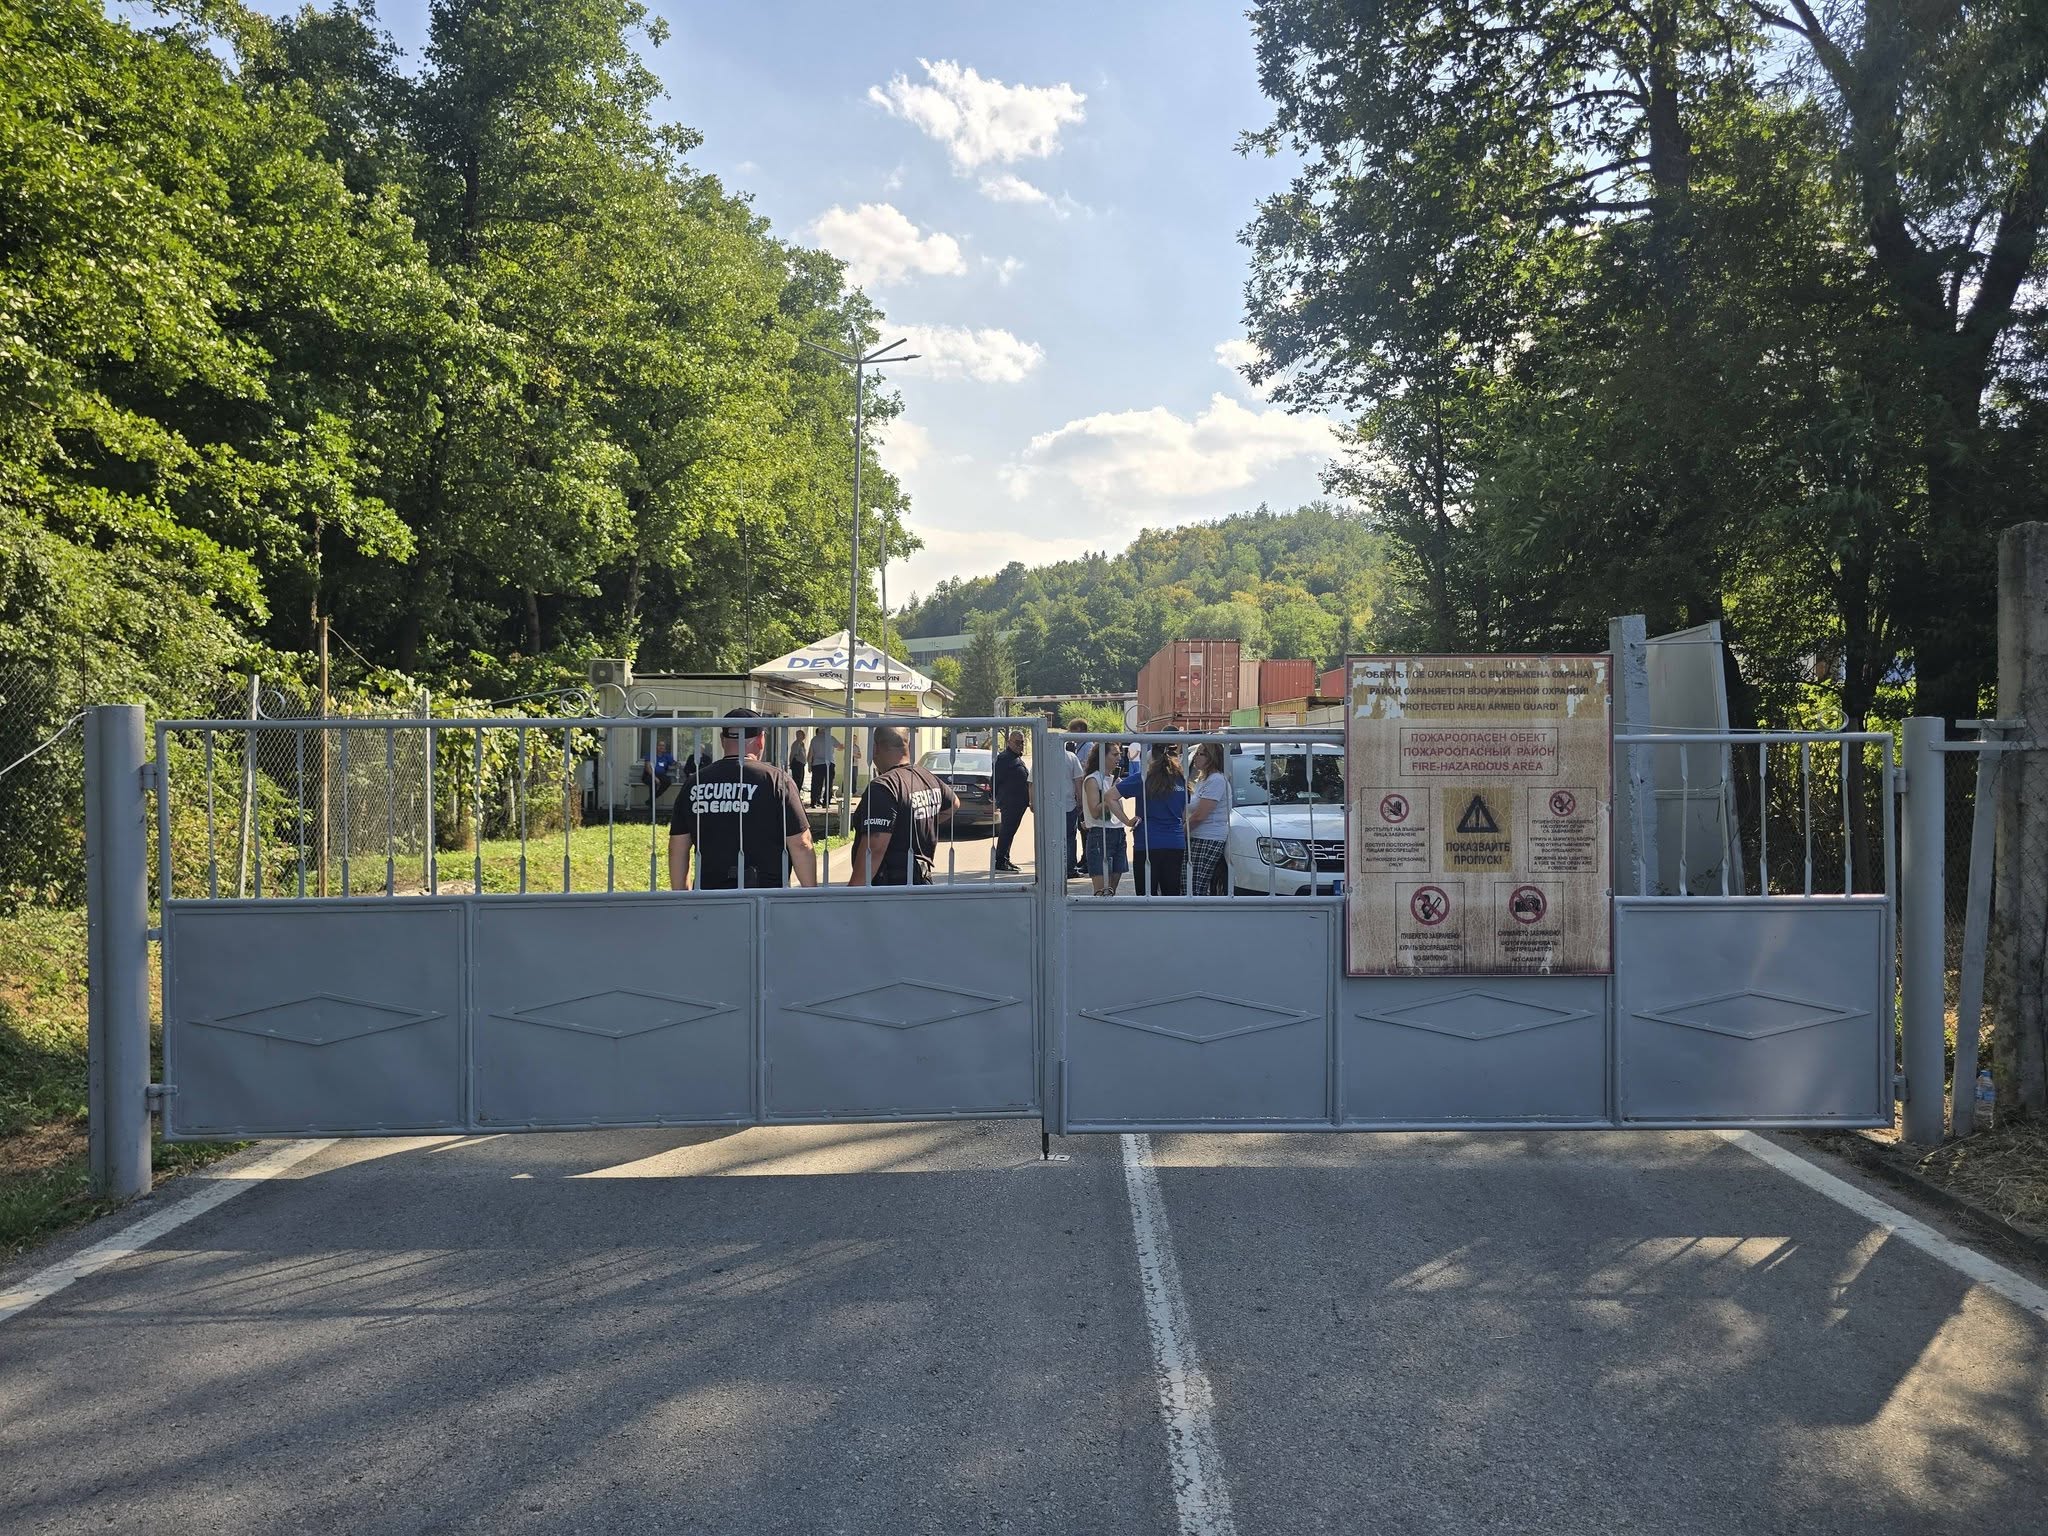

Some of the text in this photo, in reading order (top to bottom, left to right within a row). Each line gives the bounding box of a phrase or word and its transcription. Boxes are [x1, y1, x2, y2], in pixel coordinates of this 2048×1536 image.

[787, 653, 879, 670] DEVN
[1366, 671, 1409, 679] ОБЕКТЪТ
[1412, 671, 1425, 679] СЕ
[1427, 671, 1477, 679] ОХРАНЯВА
[1369, 686, 1589, 695] РАЙОН ОХРАНЯЕТСЯ ВООРУЖЕННОЙ ОХРАНОЙ!
[1400, 703, 1559, 711] PROTECTED AREA! ARMED GUARD!
[1411, 733, 1547, 742] ПОЖАРООПАСЕН ОБЕКТ
[1403, 746, 1555, 756] ПОЖАРООПАСНЫЙ РАЙОН
[1412, 762, 1543, 771] FIRE-HAZARDOUS AREA
[689, 783, 758, 801] SECURITY
[1446, 841, 1511, 852] ПОКАЗВАЙТЕ
[1454, 855, 1502, 865] ПРОПУСК!
